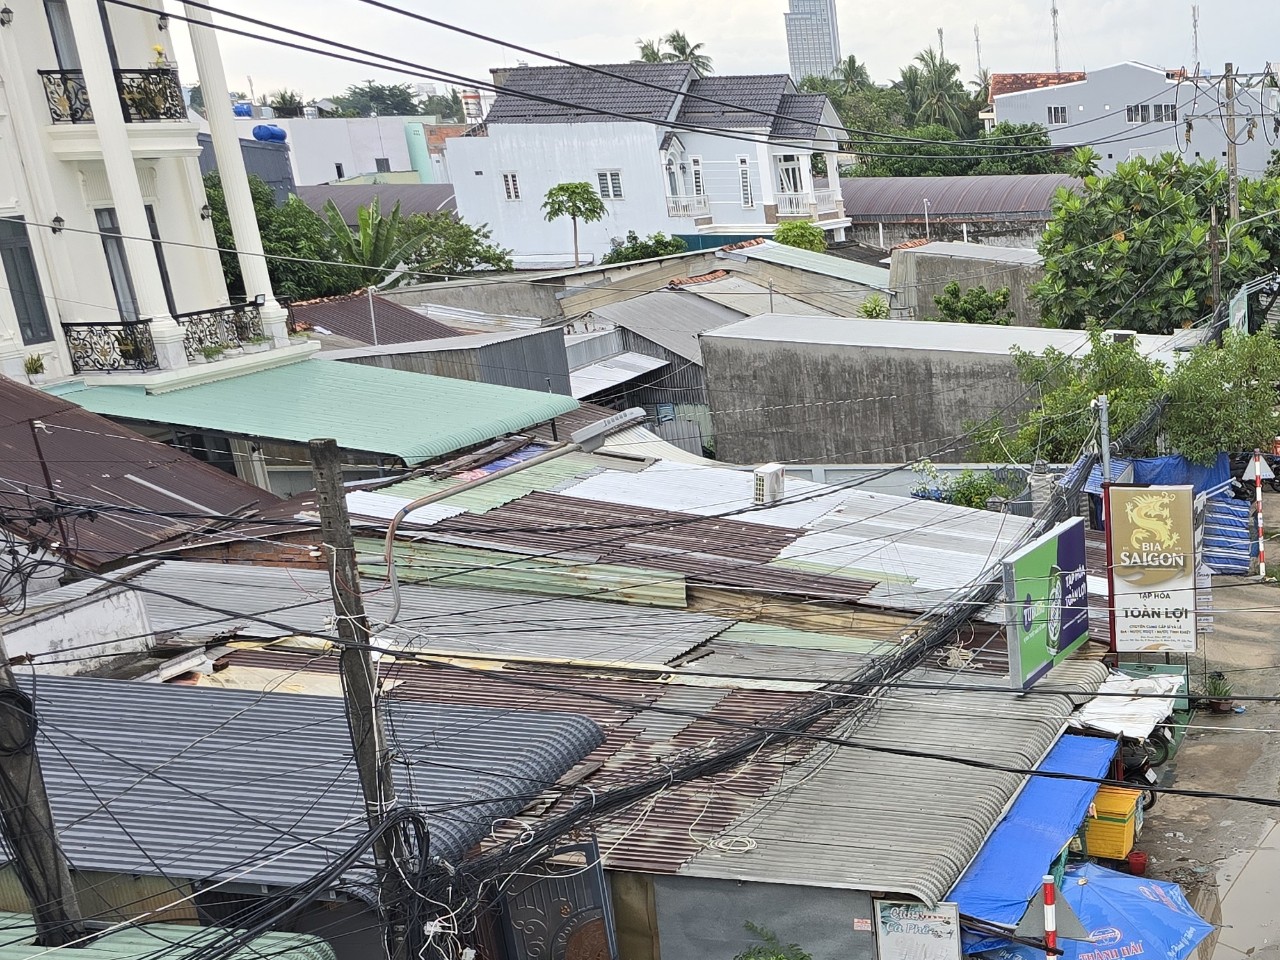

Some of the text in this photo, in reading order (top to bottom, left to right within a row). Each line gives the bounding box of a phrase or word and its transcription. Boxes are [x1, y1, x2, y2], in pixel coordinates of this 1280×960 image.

[1142, 542, 1162, 551] BIA
[1120, 551, 1184, 566] SAIGON
[1139, 592, 1153, 601] TẠP
[1122, 604, 1188, 623] TOÀN LỢI
